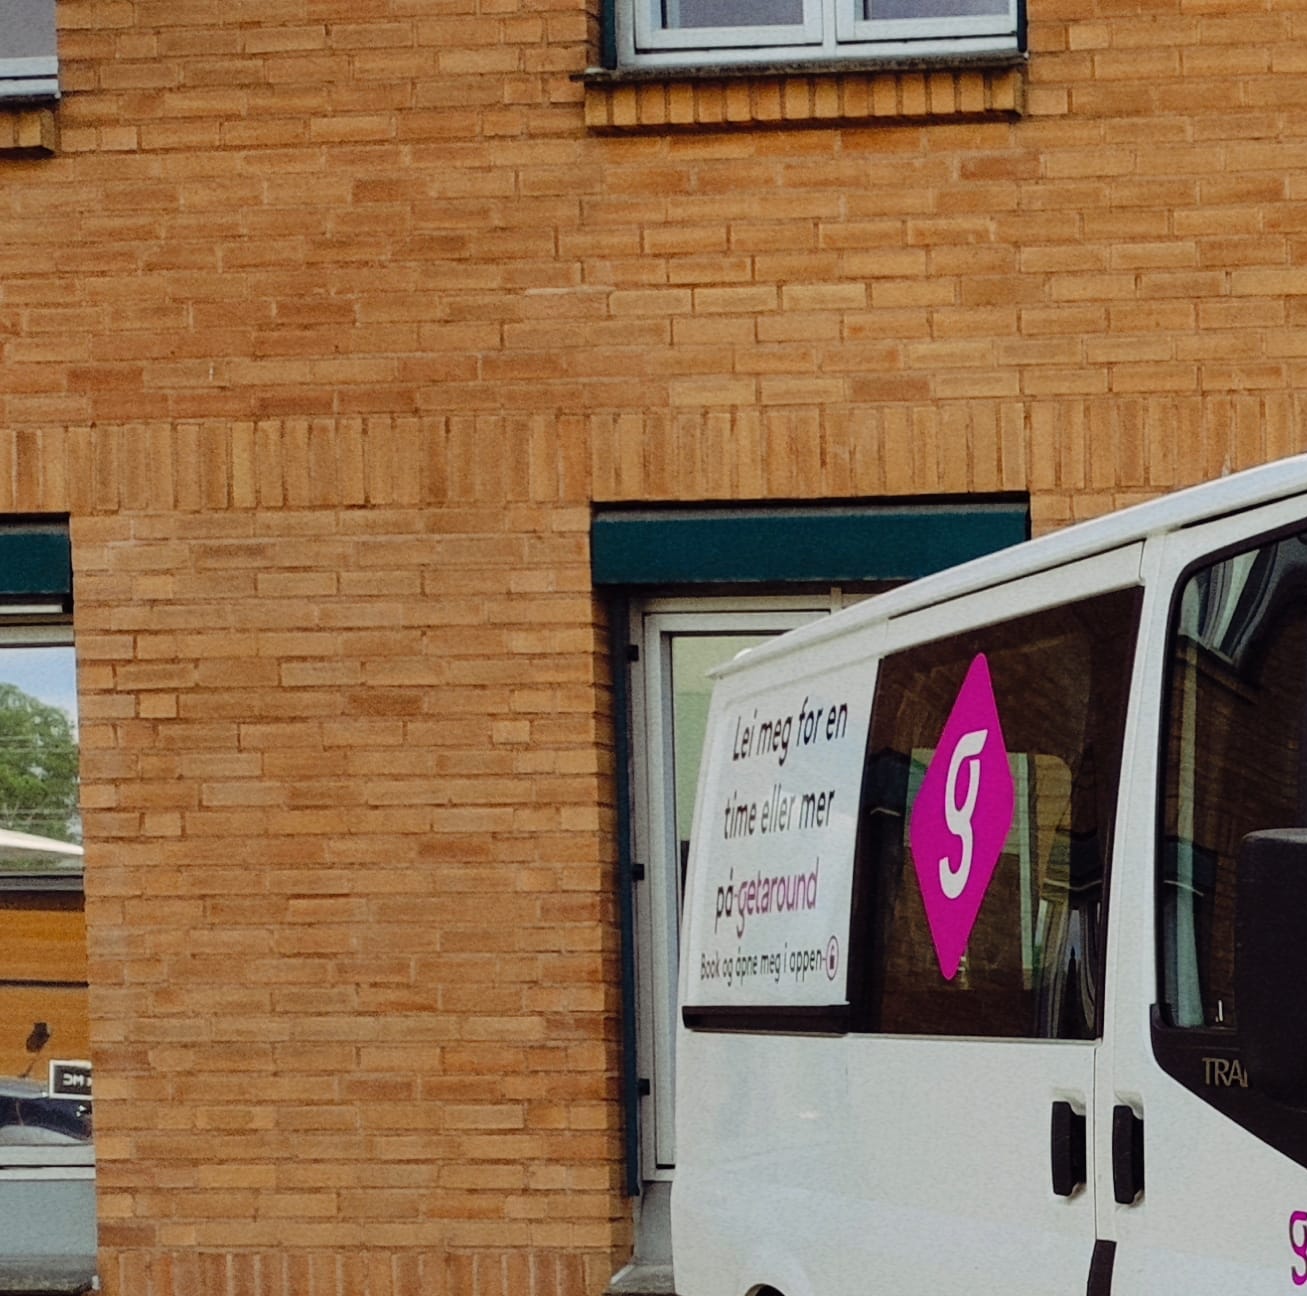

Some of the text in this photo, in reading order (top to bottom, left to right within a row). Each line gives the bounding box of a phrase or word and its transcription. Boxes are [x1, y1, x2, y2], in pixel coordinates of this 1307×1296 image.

[732, 696, 848, 767] Lei meg for en
[723, 783, 836, 840] time eller mer
[701, 950, 721, 981] Book
[723, 957, 734, 987] og
[735, 946, 758, 986] åpne
[759, 952, 782, 984] meg
[789, 949, 823, 983] appen
